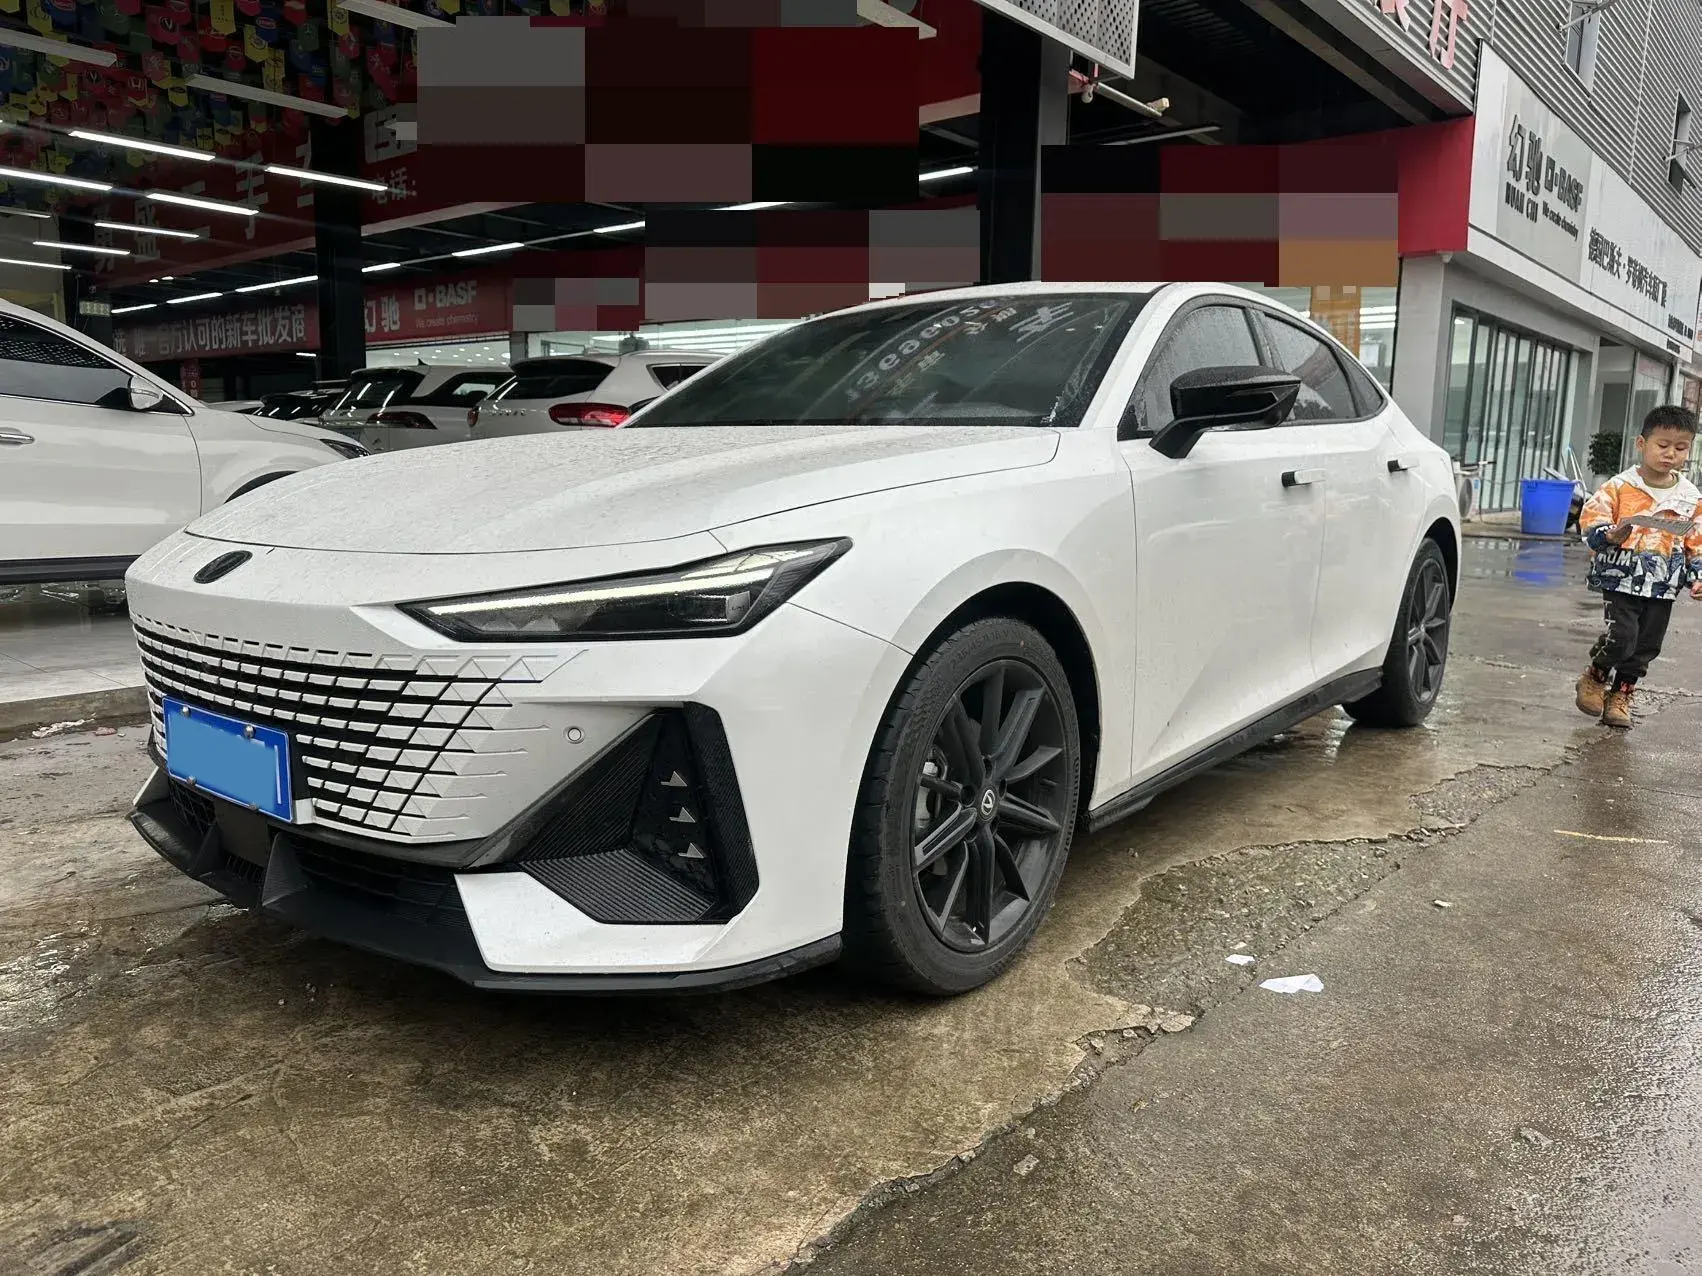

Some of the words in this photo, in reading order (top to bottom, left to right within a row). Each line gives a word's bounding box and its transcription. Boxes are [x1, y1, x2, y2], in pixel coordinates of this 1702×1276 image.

[1504, 181, 1524, 214] HUAN
[1526, 199, 1539, 223] CHI
[435, 280, 477, 308] BASF
